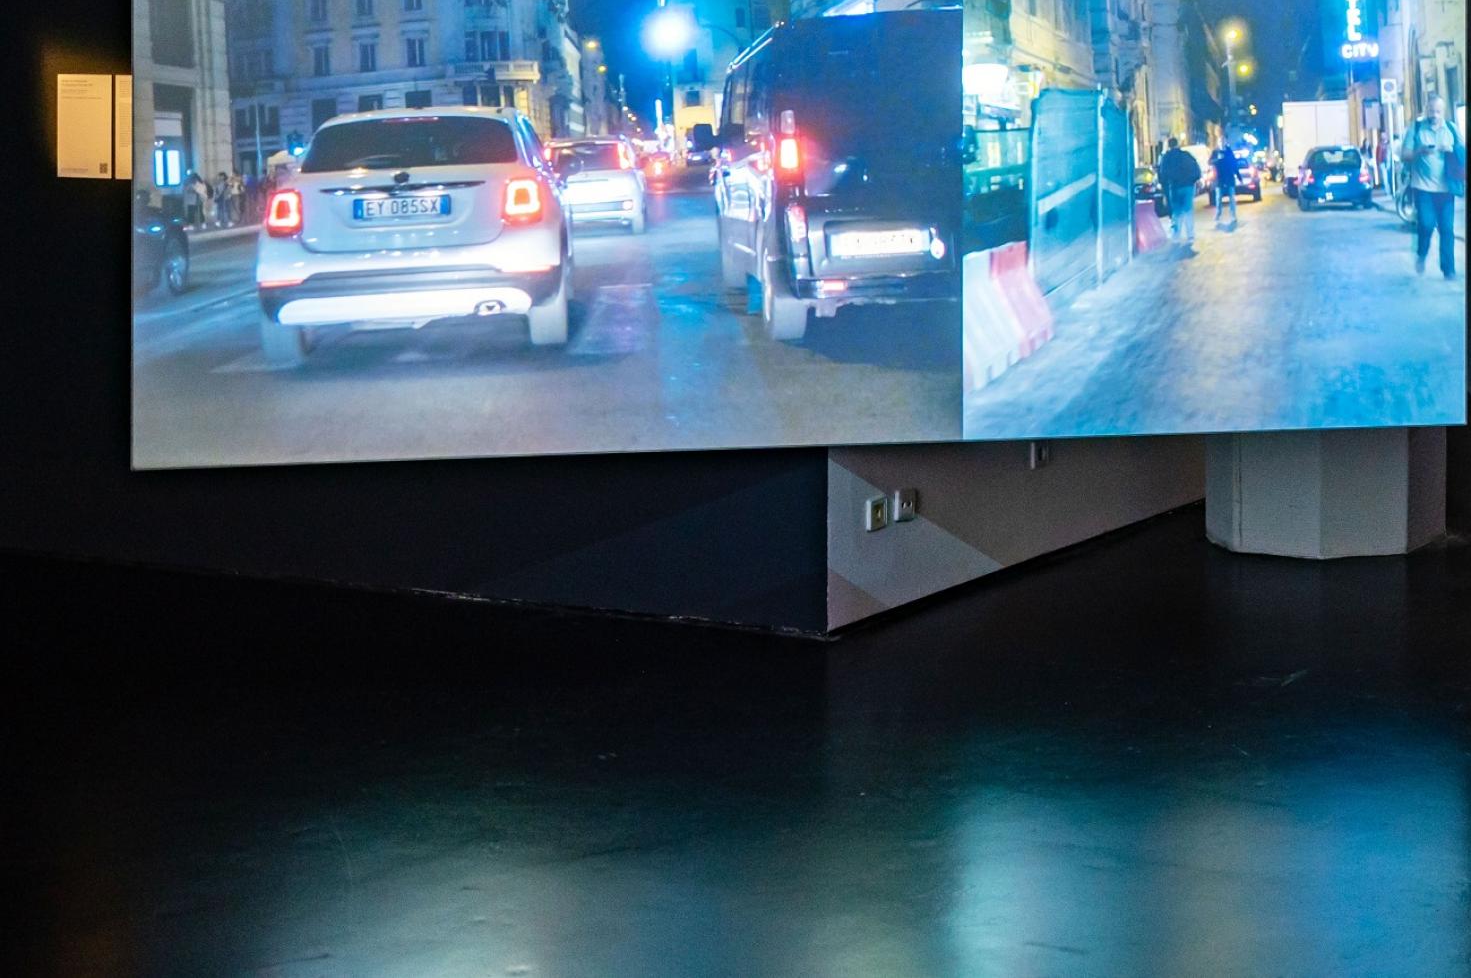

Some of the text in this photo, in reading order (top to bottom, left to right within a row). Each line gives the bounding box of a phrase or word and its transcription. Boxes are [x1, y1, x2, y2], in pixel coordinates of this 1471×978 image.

[1341, 42, 1379, 59] CITY
[366, 198, 438, 216] EY 085SX
